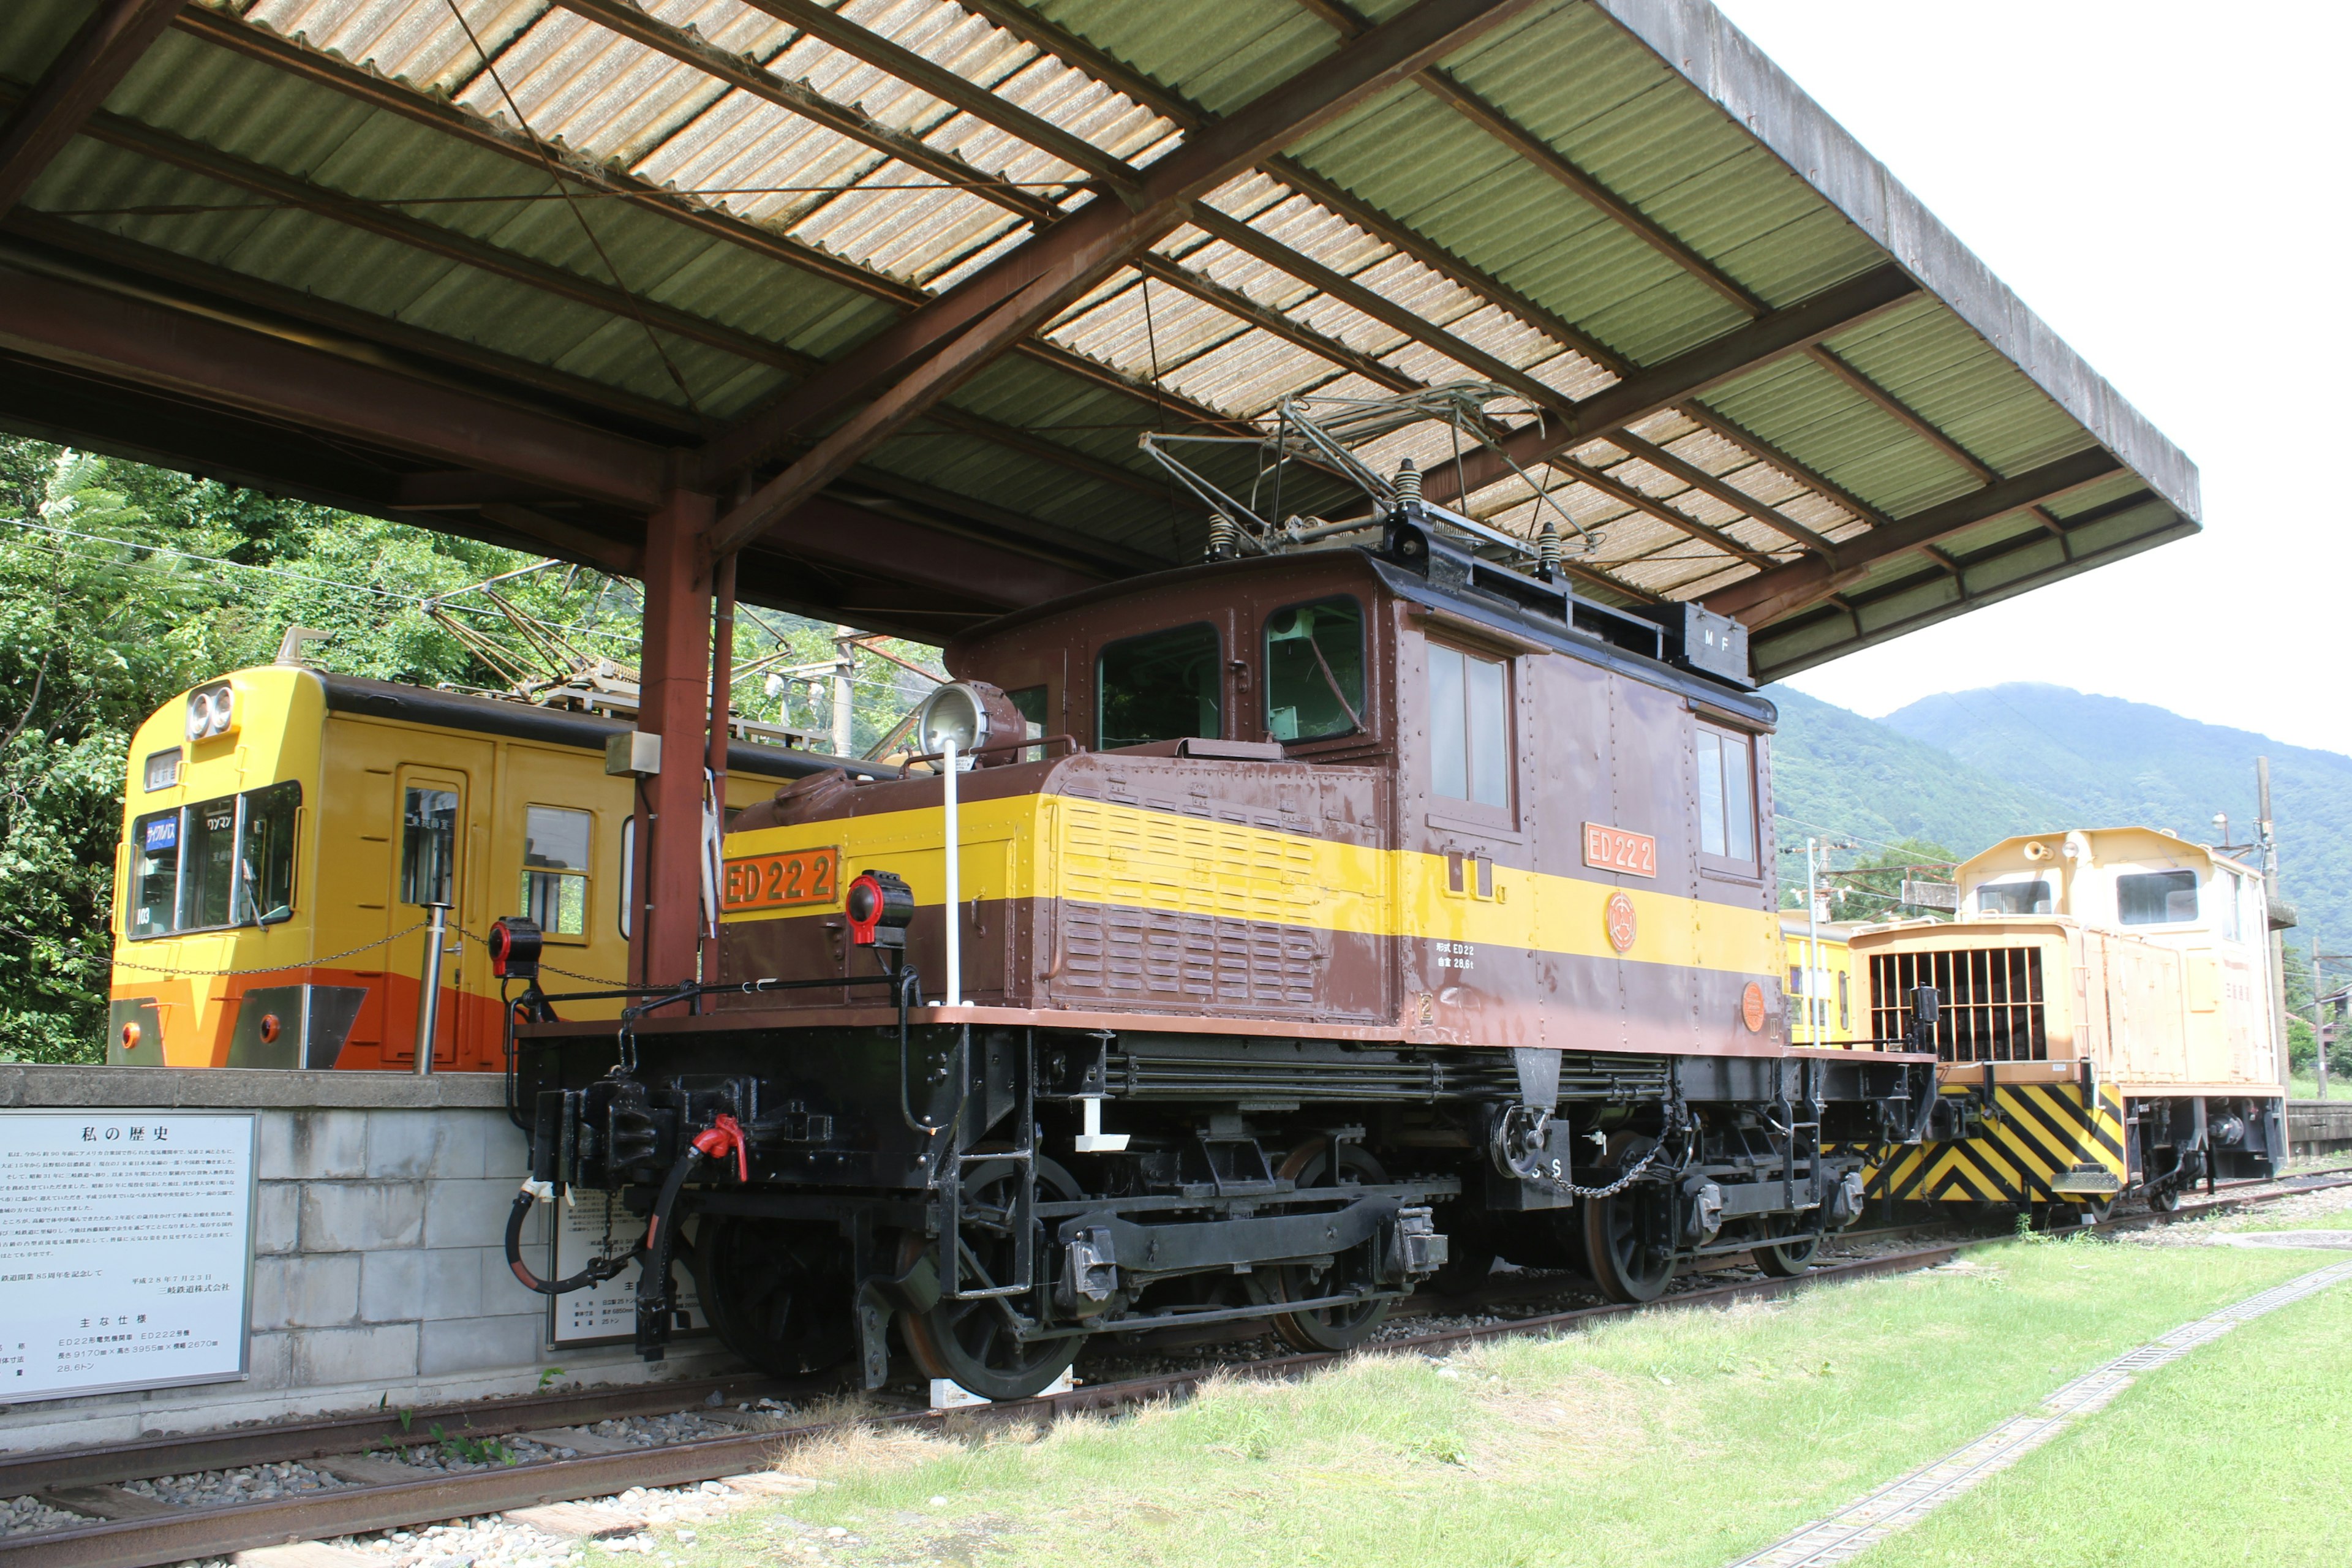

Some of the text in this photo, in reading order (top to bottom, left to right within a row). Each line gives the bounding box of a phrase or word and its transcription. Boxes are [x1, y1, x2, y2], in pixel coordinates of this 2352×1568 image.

[207, 816, 232, 831] ワンマン
[137, 907, 150, 925] 103
[1436, 942, 1474, 956] 形式 ED22
[1438, 956, 1474, 970] 自重 28.6t
[1421, 995, 1431, 1017] 2
[81, 1126, 168, 1142] 私の歴史
[132, 1274, 211, 1284] 平成28年7月23日
[158, 1283, 230, 1295] 三岐鉄道株式会社
[80, 1314, 146, 1328] 主な仕様
[57, 1363, 94, 1373] 28.6トン
